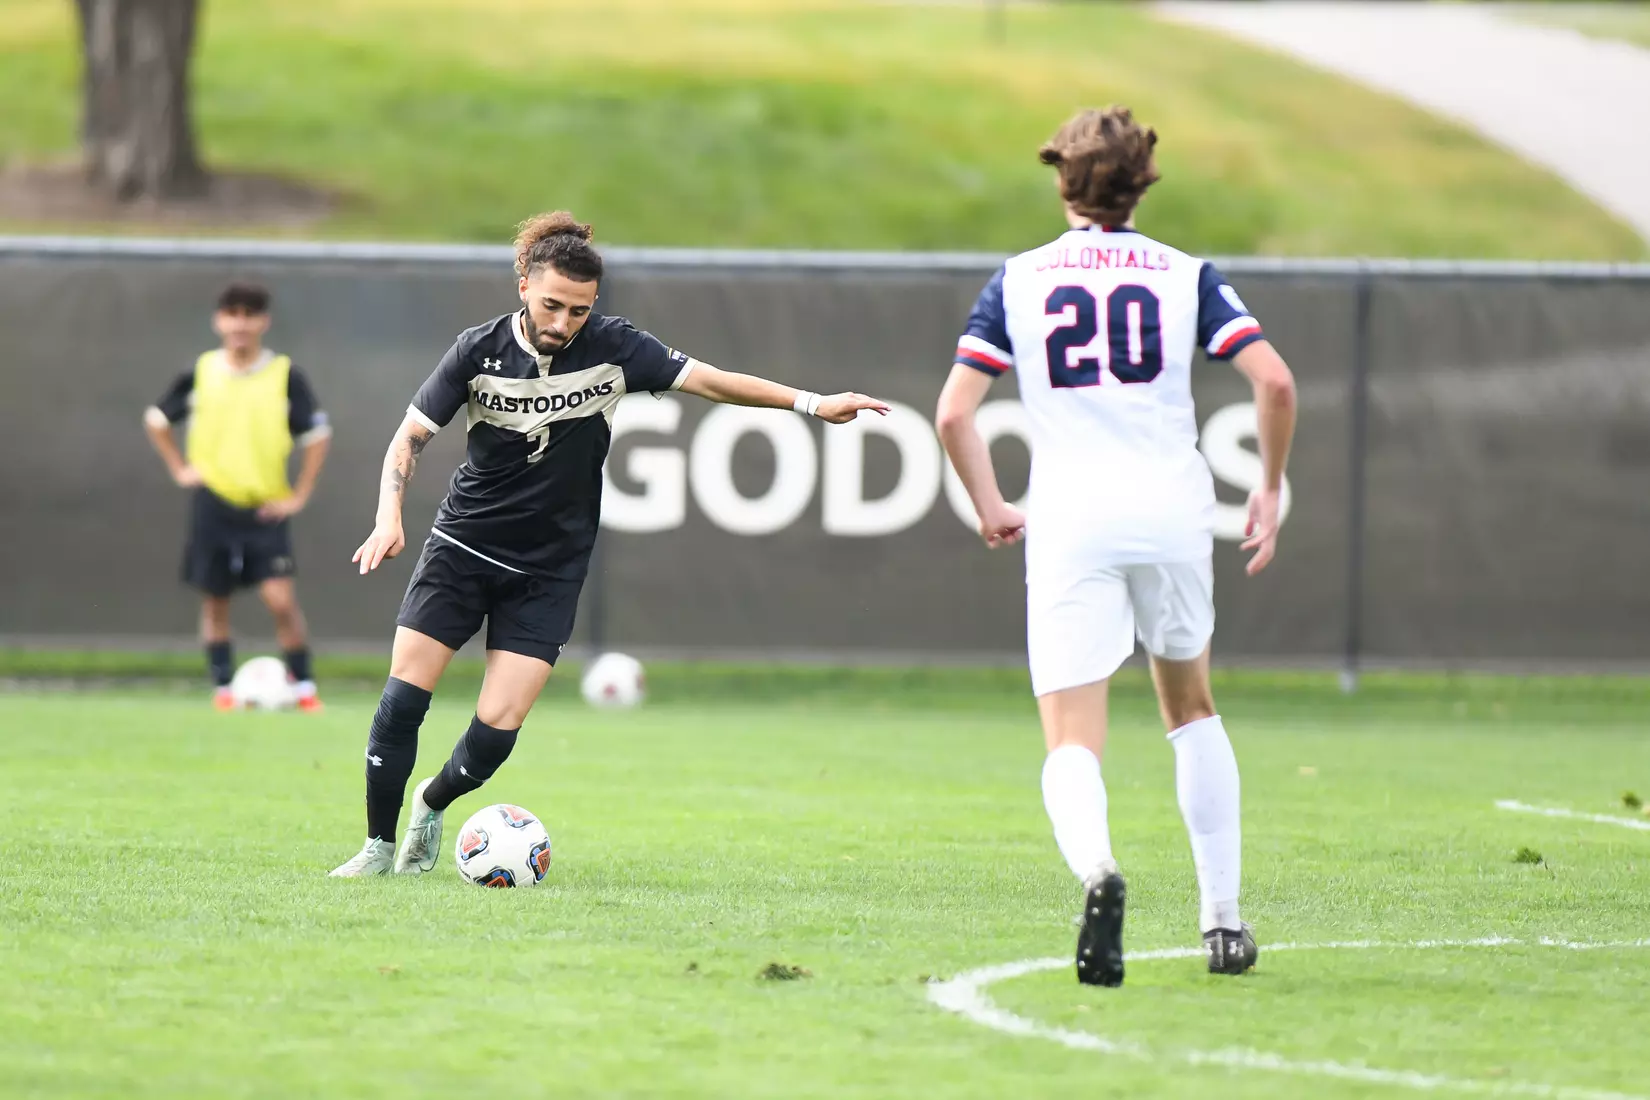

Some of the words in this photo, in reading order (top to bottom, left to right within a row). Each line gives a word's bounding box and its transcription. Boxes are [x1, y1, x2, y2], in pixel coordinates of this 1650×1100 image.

[1045, 284, 1163, 388] 20
[473, 381, 613, 414] MASTODONS
[526, 425, 550, 464] 7
[600, 390, 1292, 537] GODOS
